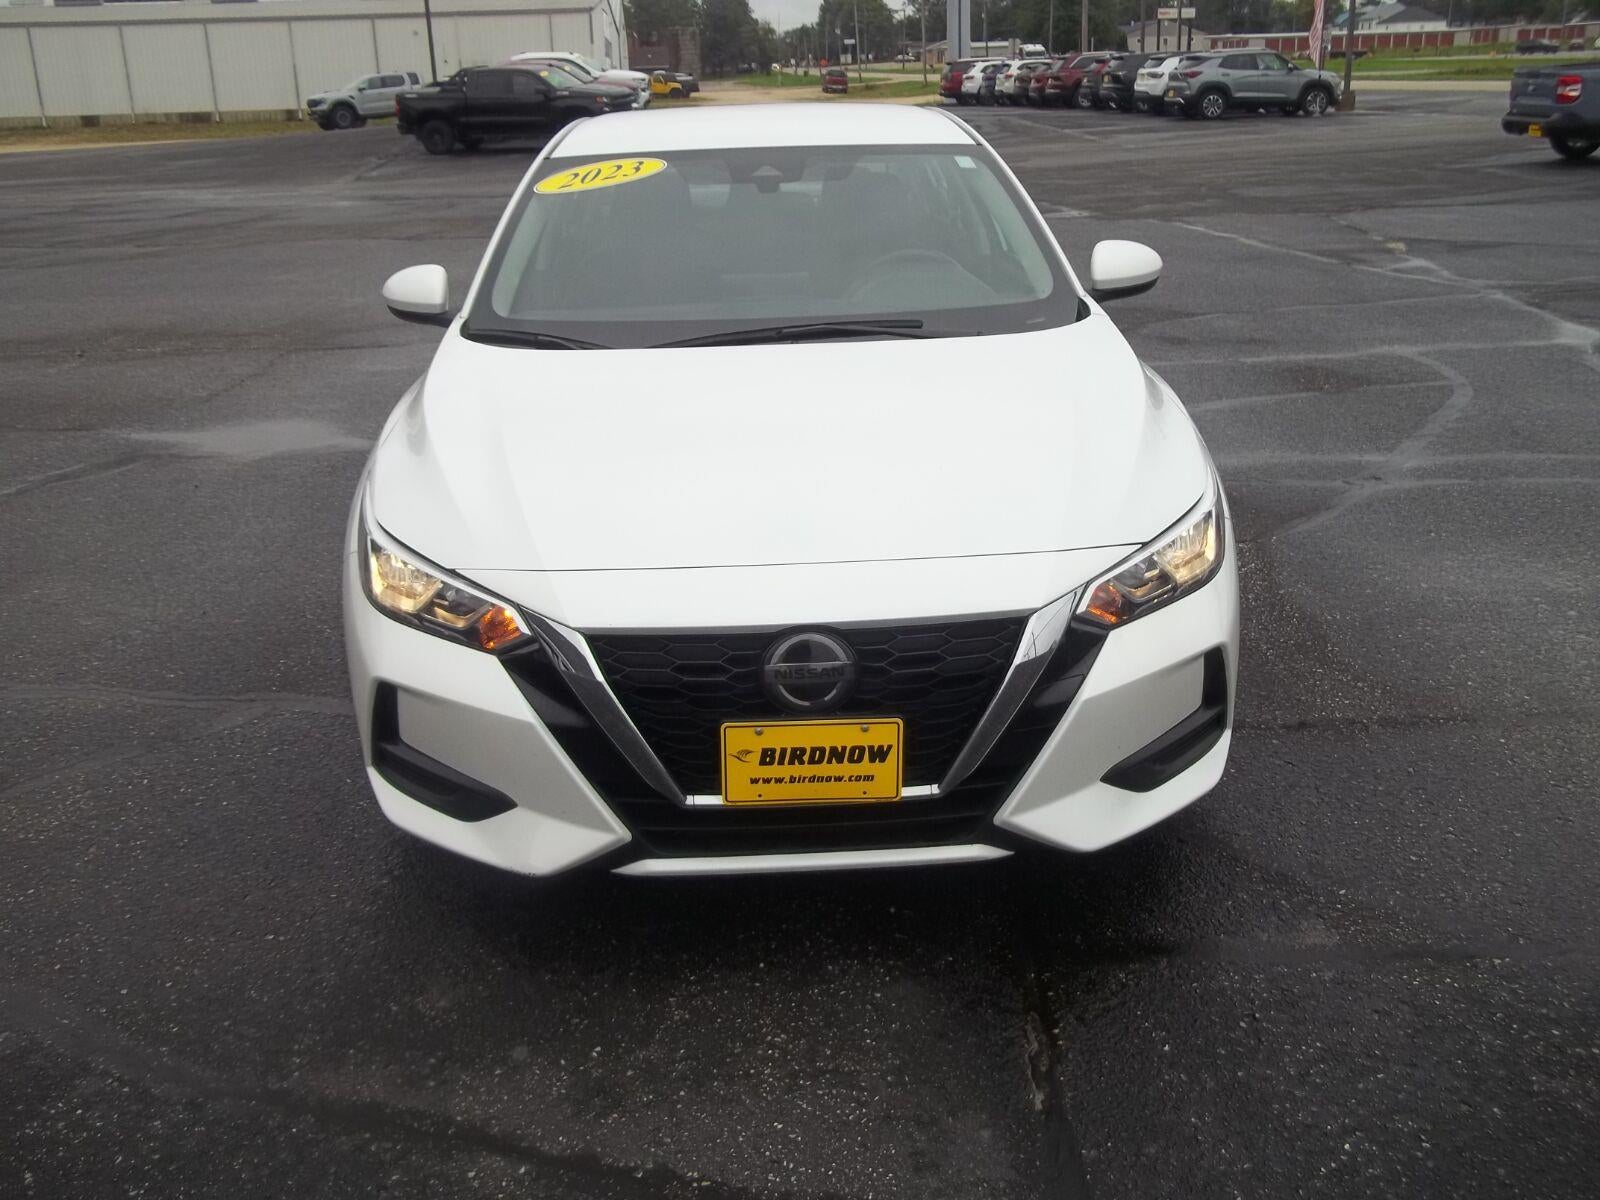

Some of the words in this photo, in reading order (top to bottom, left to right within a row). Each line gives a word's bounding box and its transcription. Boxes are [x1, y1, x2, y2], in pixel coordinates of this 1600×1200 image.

[557, 161, 645, 190] 2023
[773, 666, 845, 681] NISSAN
[758, 744, 893, 767] BIRDNOW
[750, 773, 875, 785] www.birdnow.com
